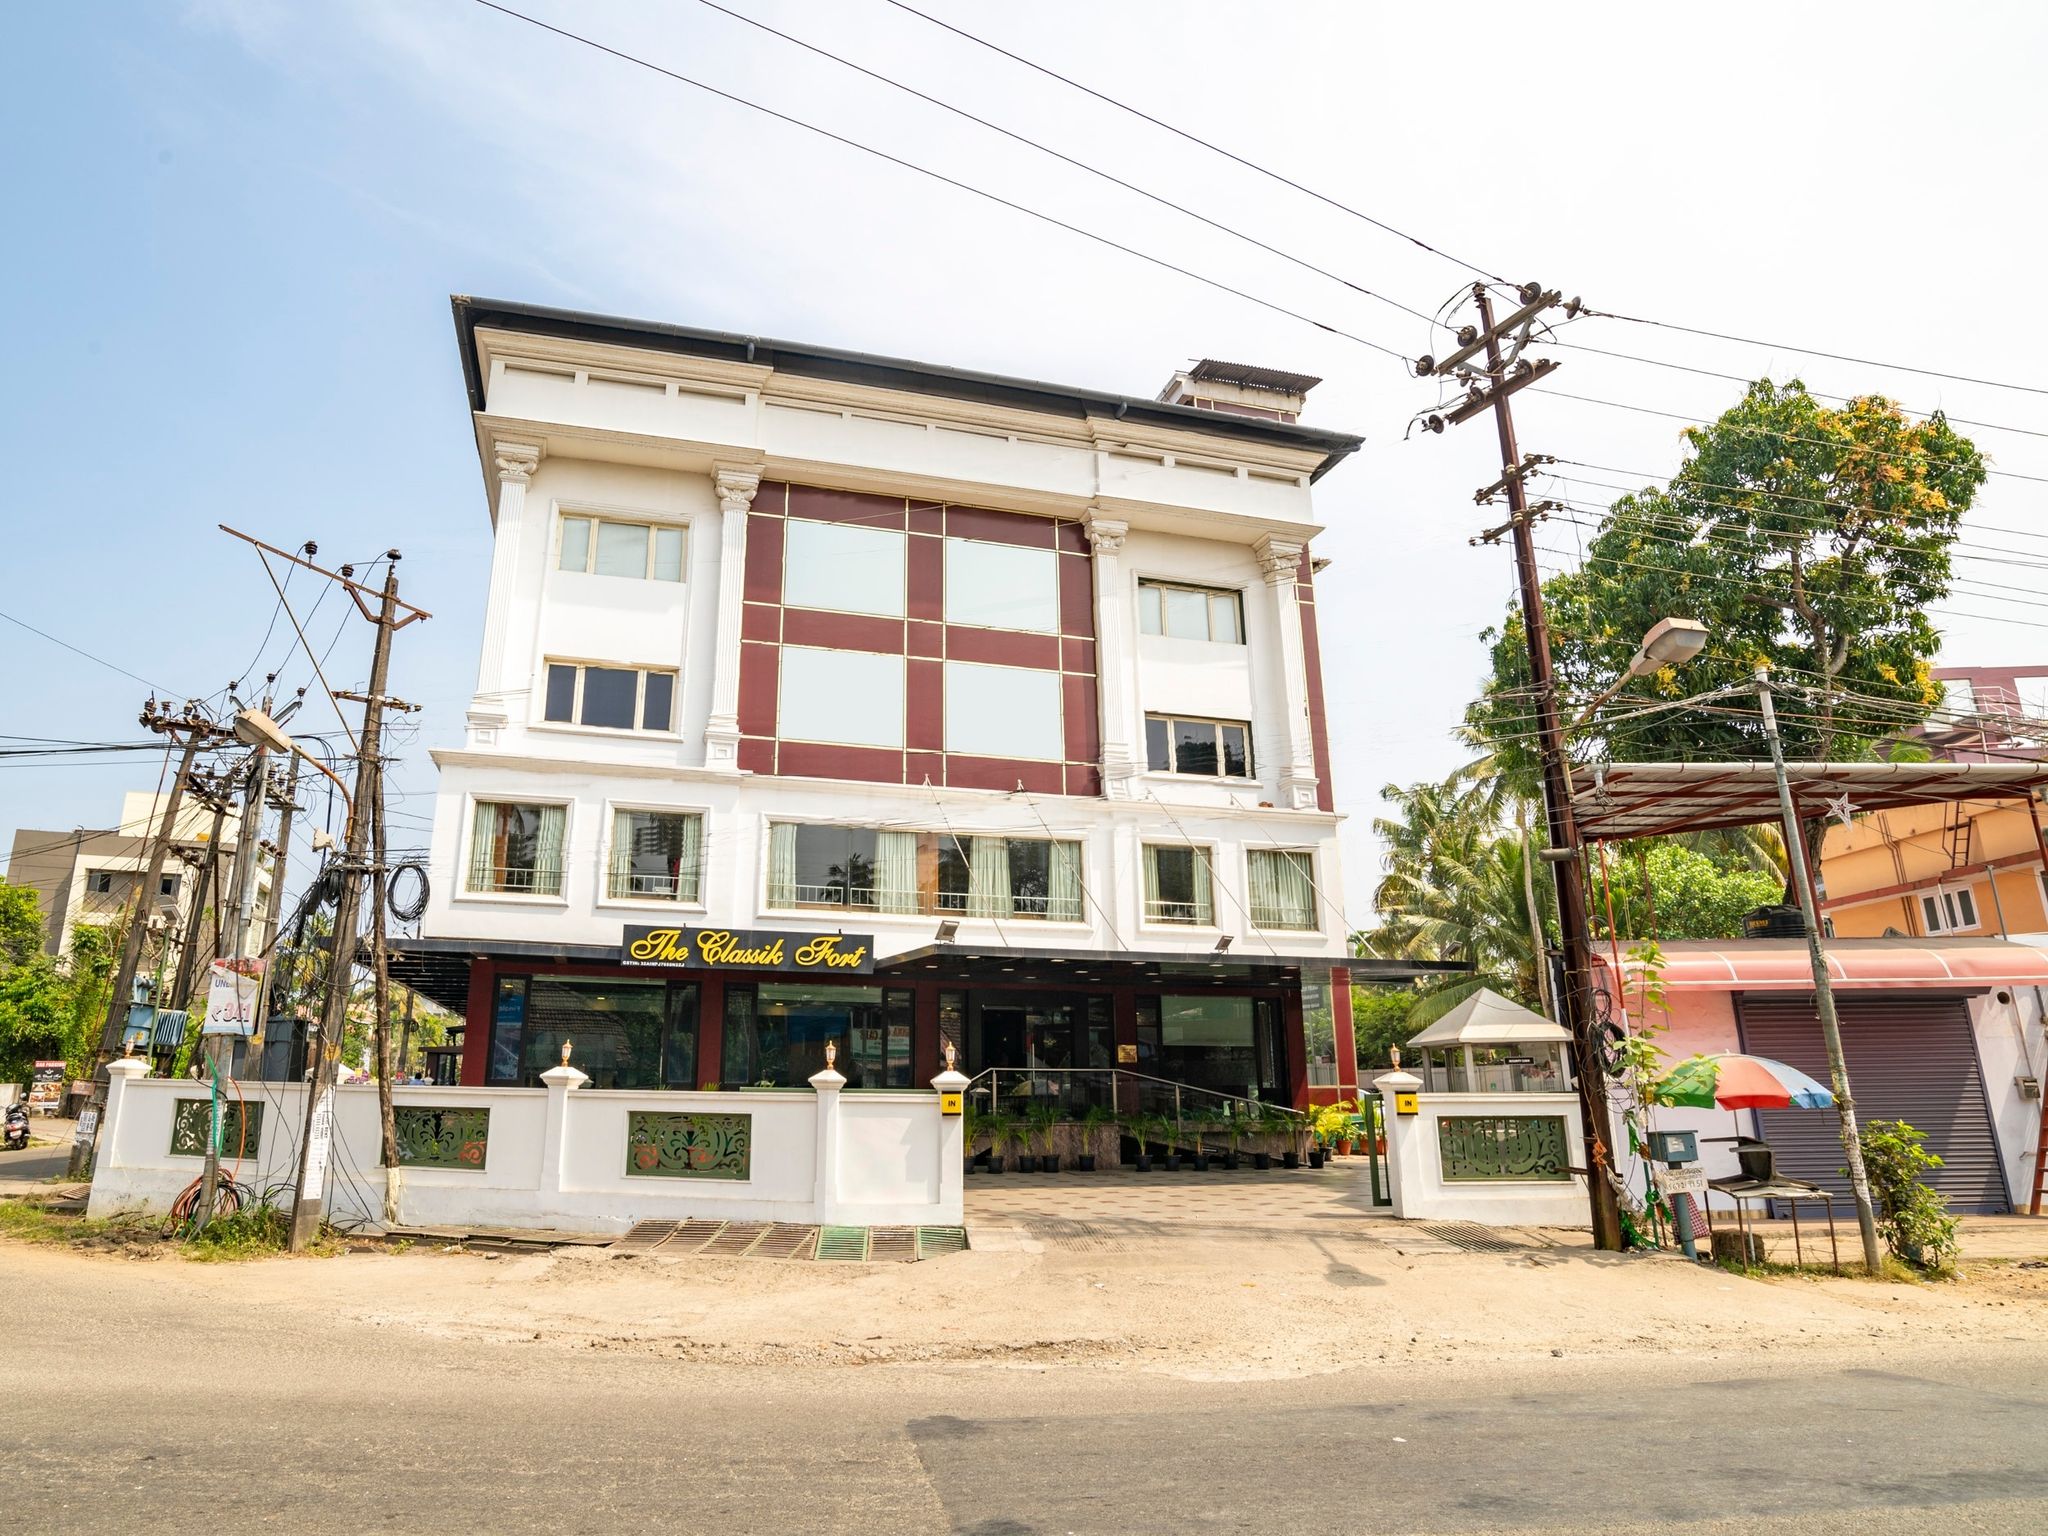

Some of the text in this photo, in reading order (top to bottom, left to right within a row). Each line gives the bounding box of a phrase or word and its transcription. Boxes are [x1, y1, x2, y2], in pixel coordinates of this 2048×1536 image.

[630, 929, 867, 968] The Classik Fort
